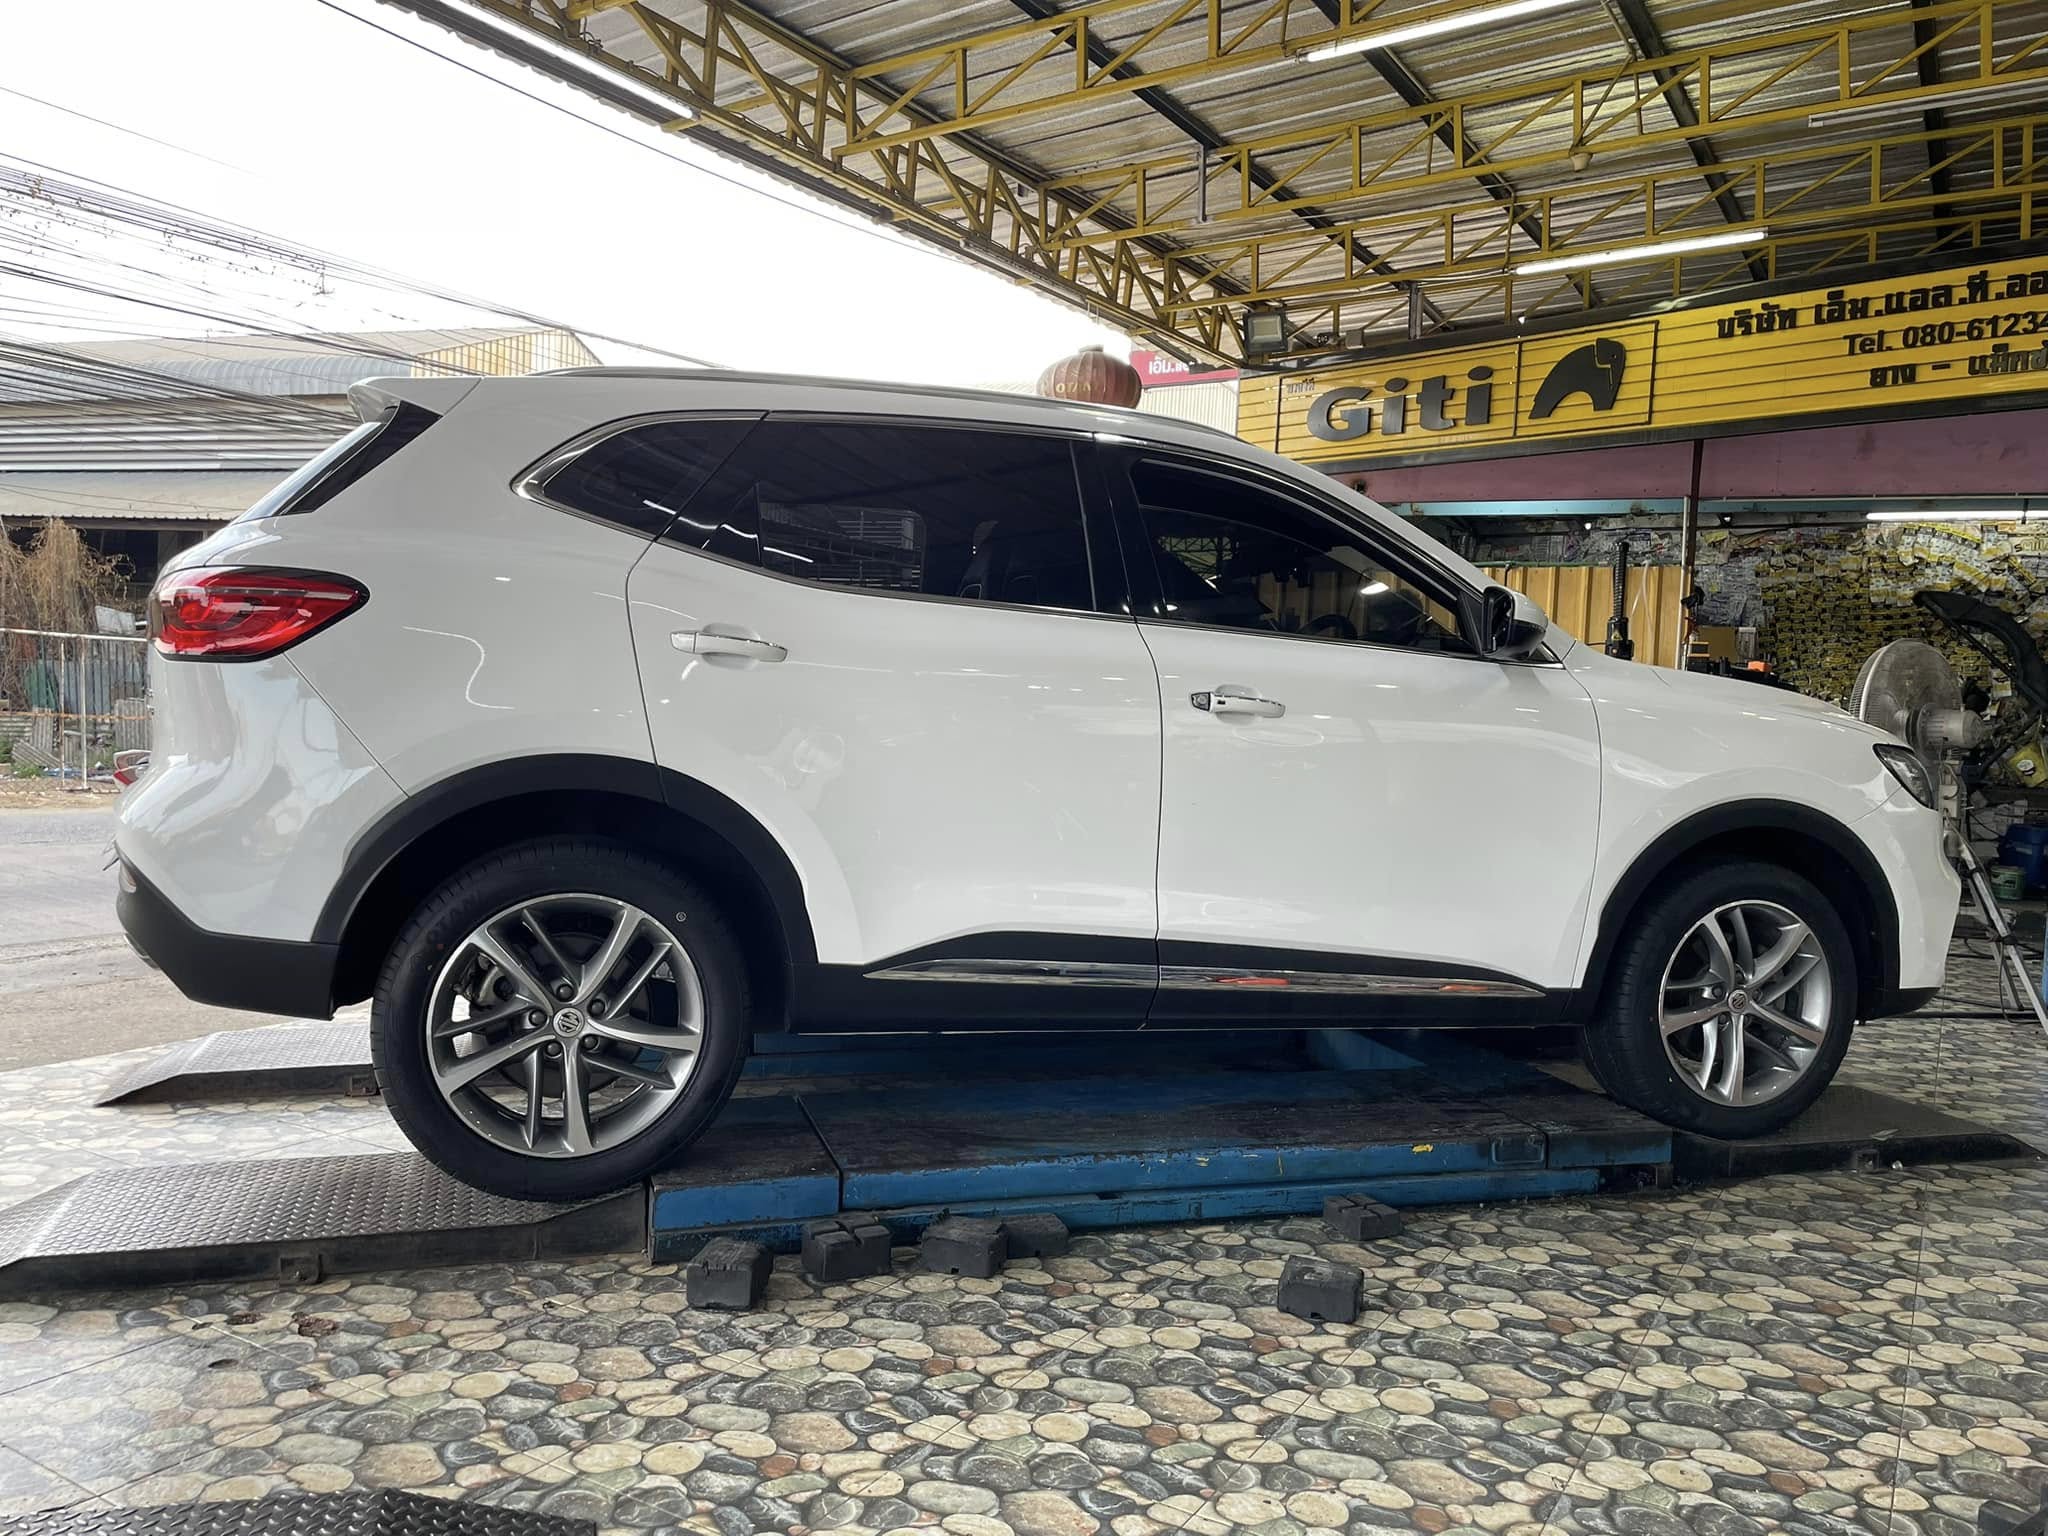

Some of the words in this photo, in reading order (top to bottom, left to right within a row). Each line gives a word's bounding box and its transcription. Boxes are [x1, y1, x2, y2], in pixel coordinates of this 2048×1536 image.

[1717, 303, 1797, 338] บริษัท
[1844, 330, 1893, 356] Tel.
[1869, 364, 1917, 387] ยาง
[1307, 366, 1493, 442] Giti
